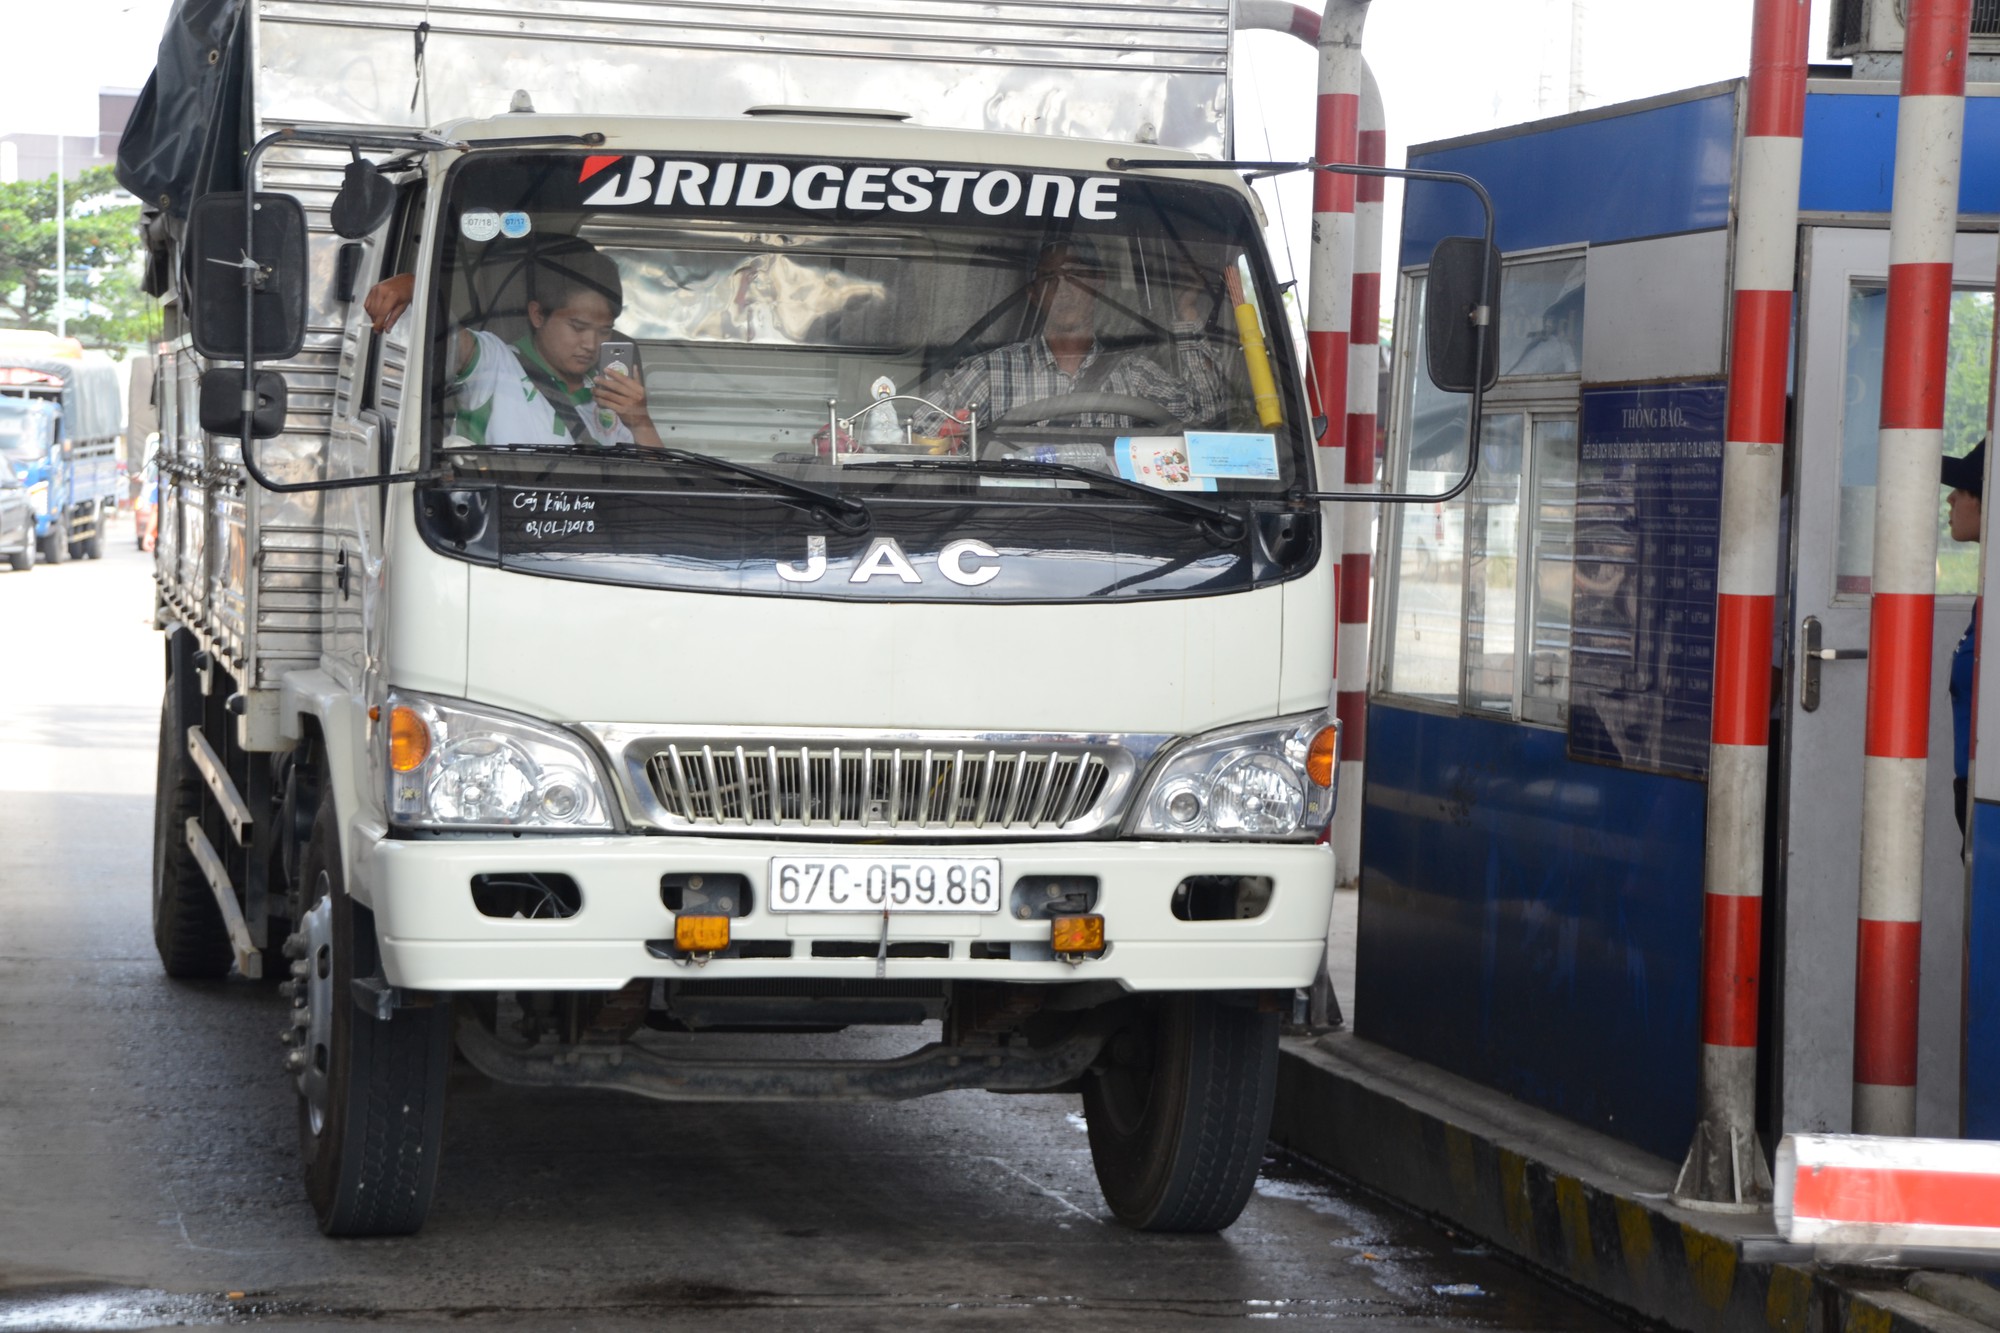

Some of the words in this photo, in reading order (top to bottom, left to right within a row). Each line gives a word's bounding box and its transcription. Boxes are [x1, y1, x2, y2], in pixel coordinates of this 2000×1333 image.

[578, 155, 1120, 220] BRIDGESTONE
[468, 218, 492, 227] 07/18
[505, 218, 525, 226] 07/17
[1621, 402, 1658, 429] THÔNG
[776, 536, 1001, 587] JAC
[779, 864, 991, 905] 67C-059.86
